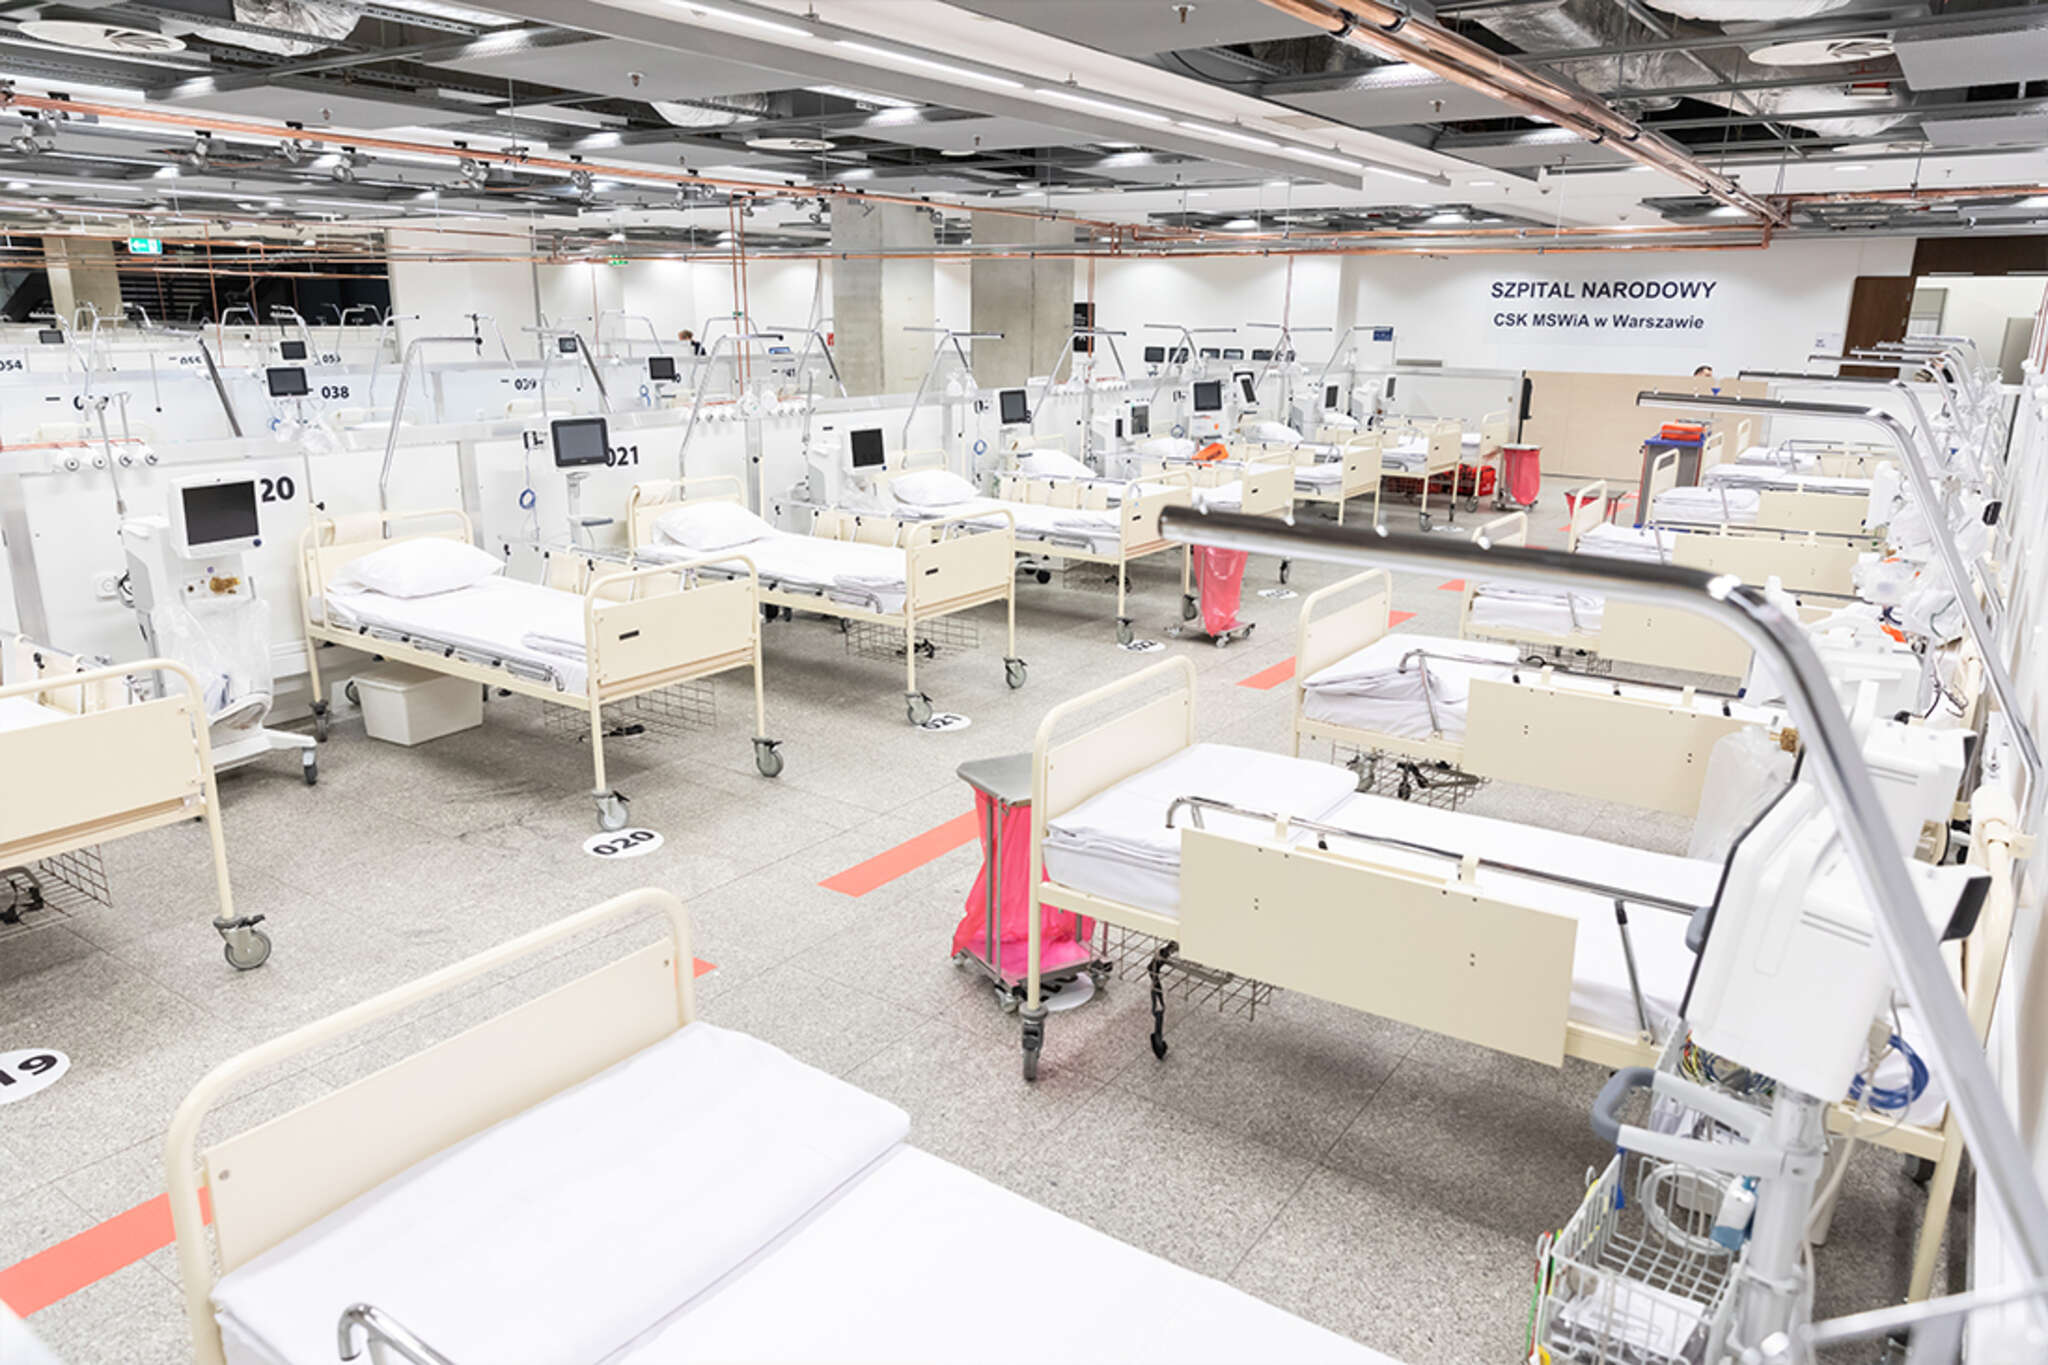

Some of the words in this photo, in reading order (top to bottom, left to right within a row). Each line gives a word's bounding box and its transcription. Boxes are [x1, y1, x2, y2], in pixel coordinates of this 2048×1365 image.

[1490, 281, 1575, 299] SZPITAL
[1581, 281, 1717, 299] NARODOWY
[1493, 313, 1528, 328] CSK
[1532, 313, 1590, 328] MSWiA
[1594, 316, 1608, 328] w
[1612, 314, 1705, 329] Warszawie
[321, 385, 350, 399] 038
[259, 476, 296, 503] 20
[593, 831, 655, 855] 020
